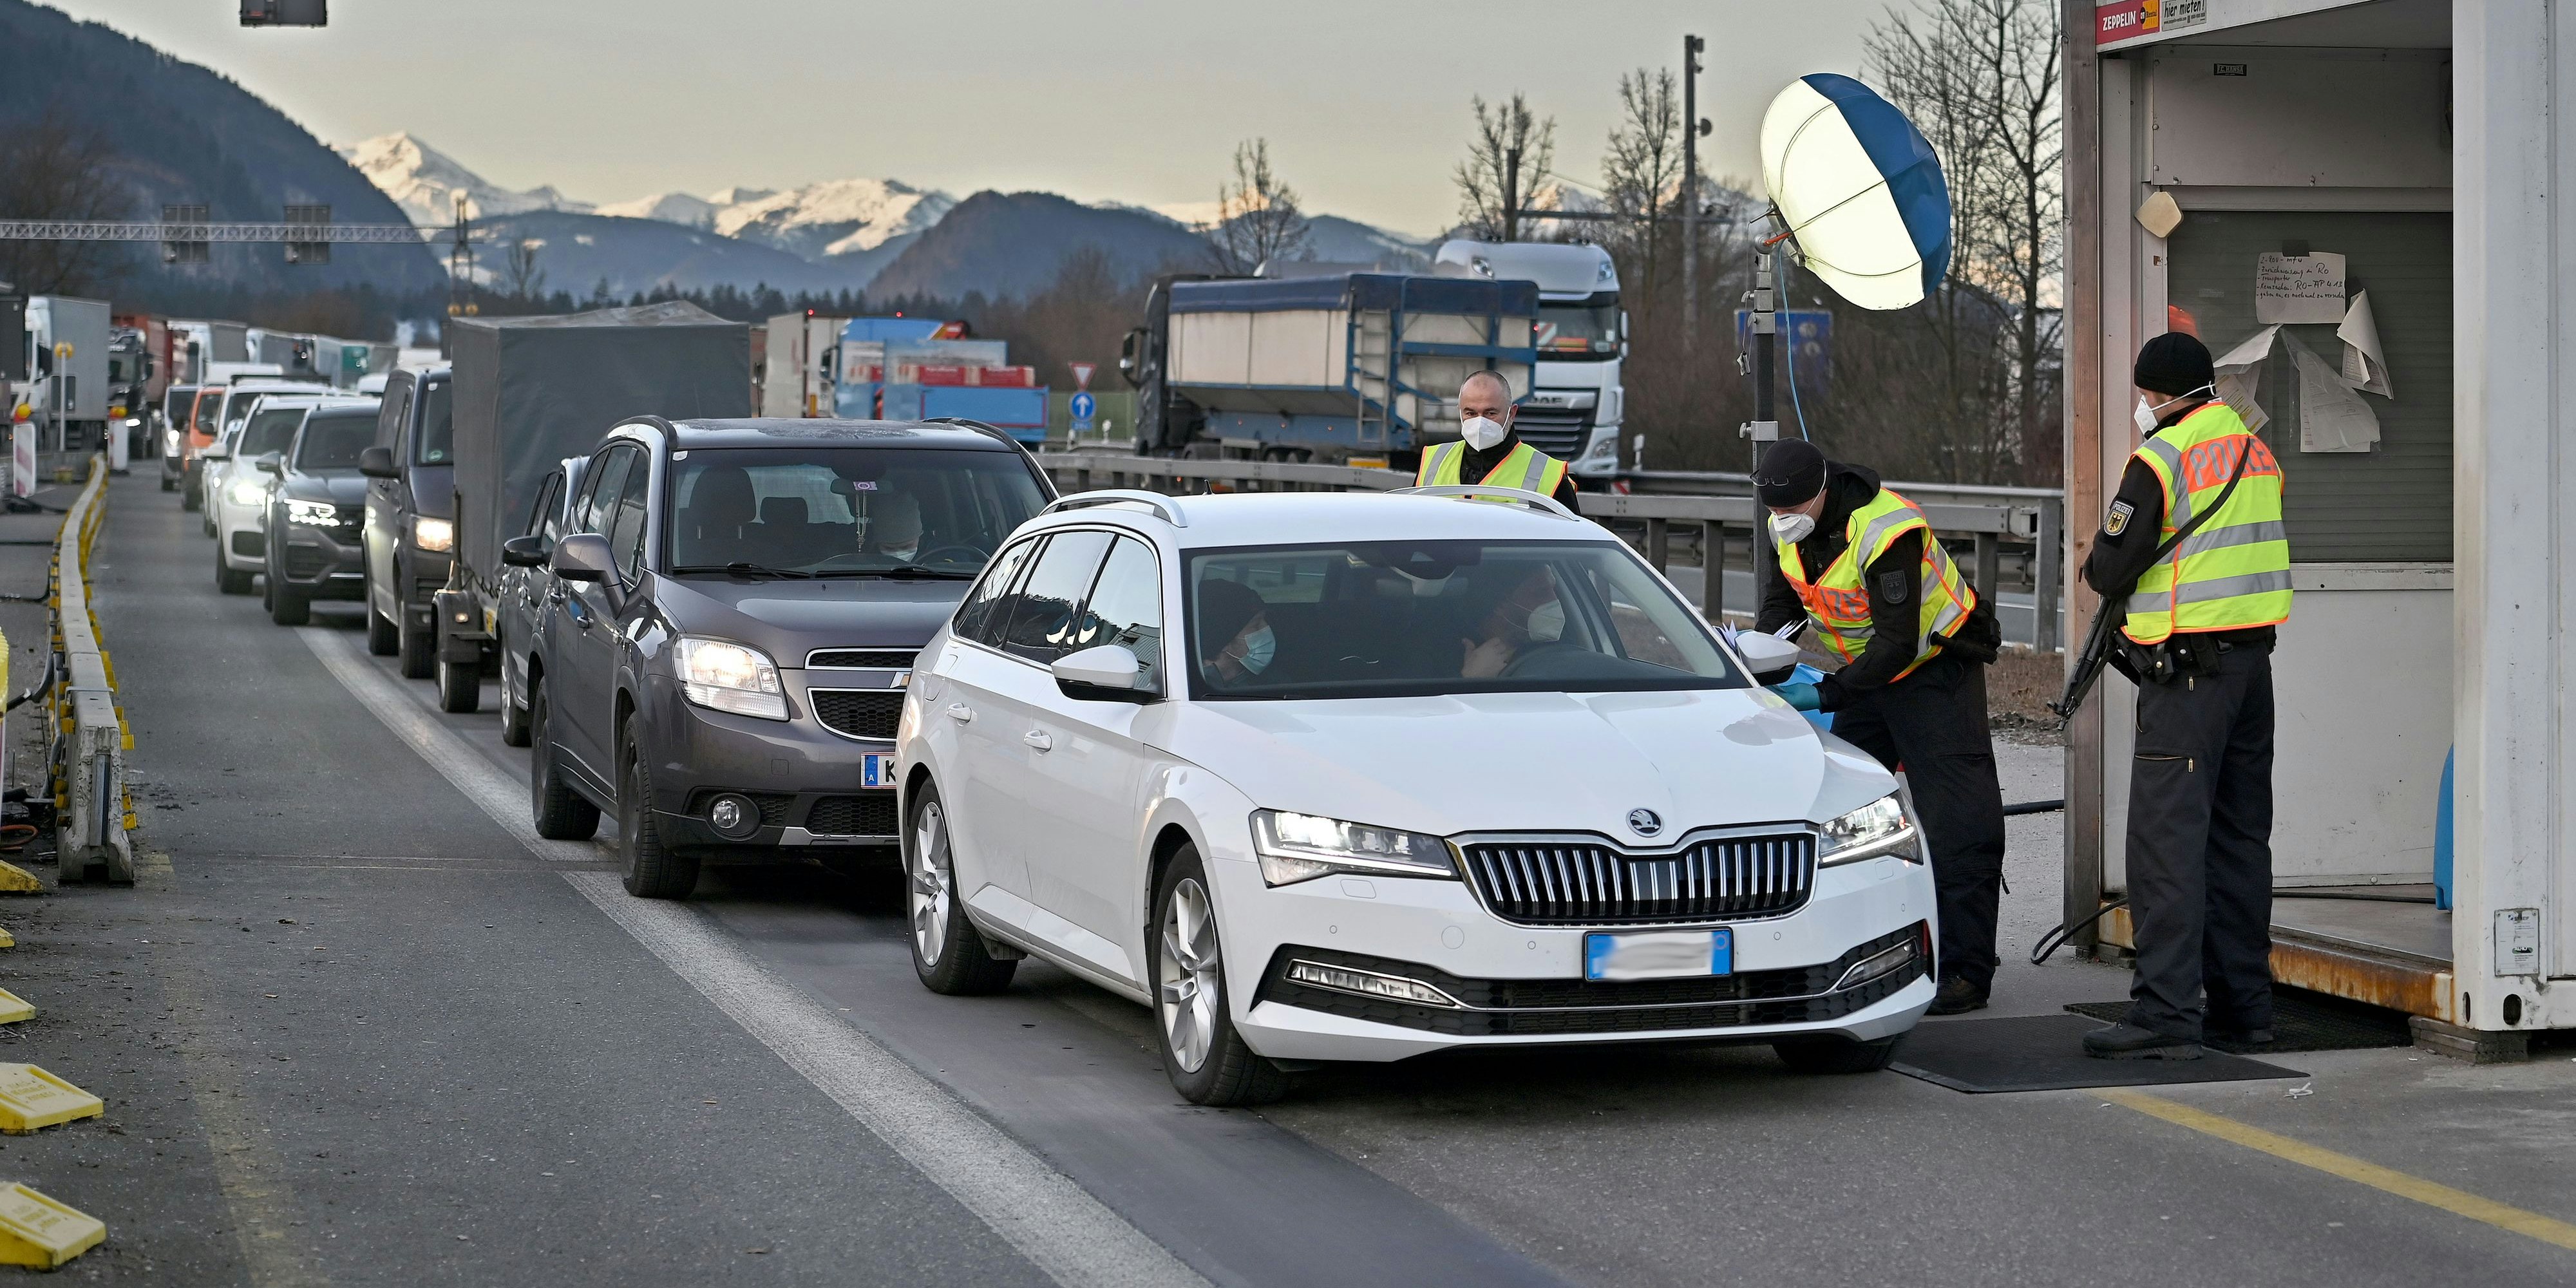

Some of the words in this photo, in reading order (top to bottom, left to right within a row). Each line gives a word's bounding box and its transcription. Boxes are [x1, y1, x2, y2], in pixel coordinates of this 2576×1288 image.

[2164, 1, 2177, 18] hier
[2103, 11, 2136, 31] ZEPPELIN
[2114, 502, 2131, 515] POLIZEI
[886, 760, 896, 782] K
